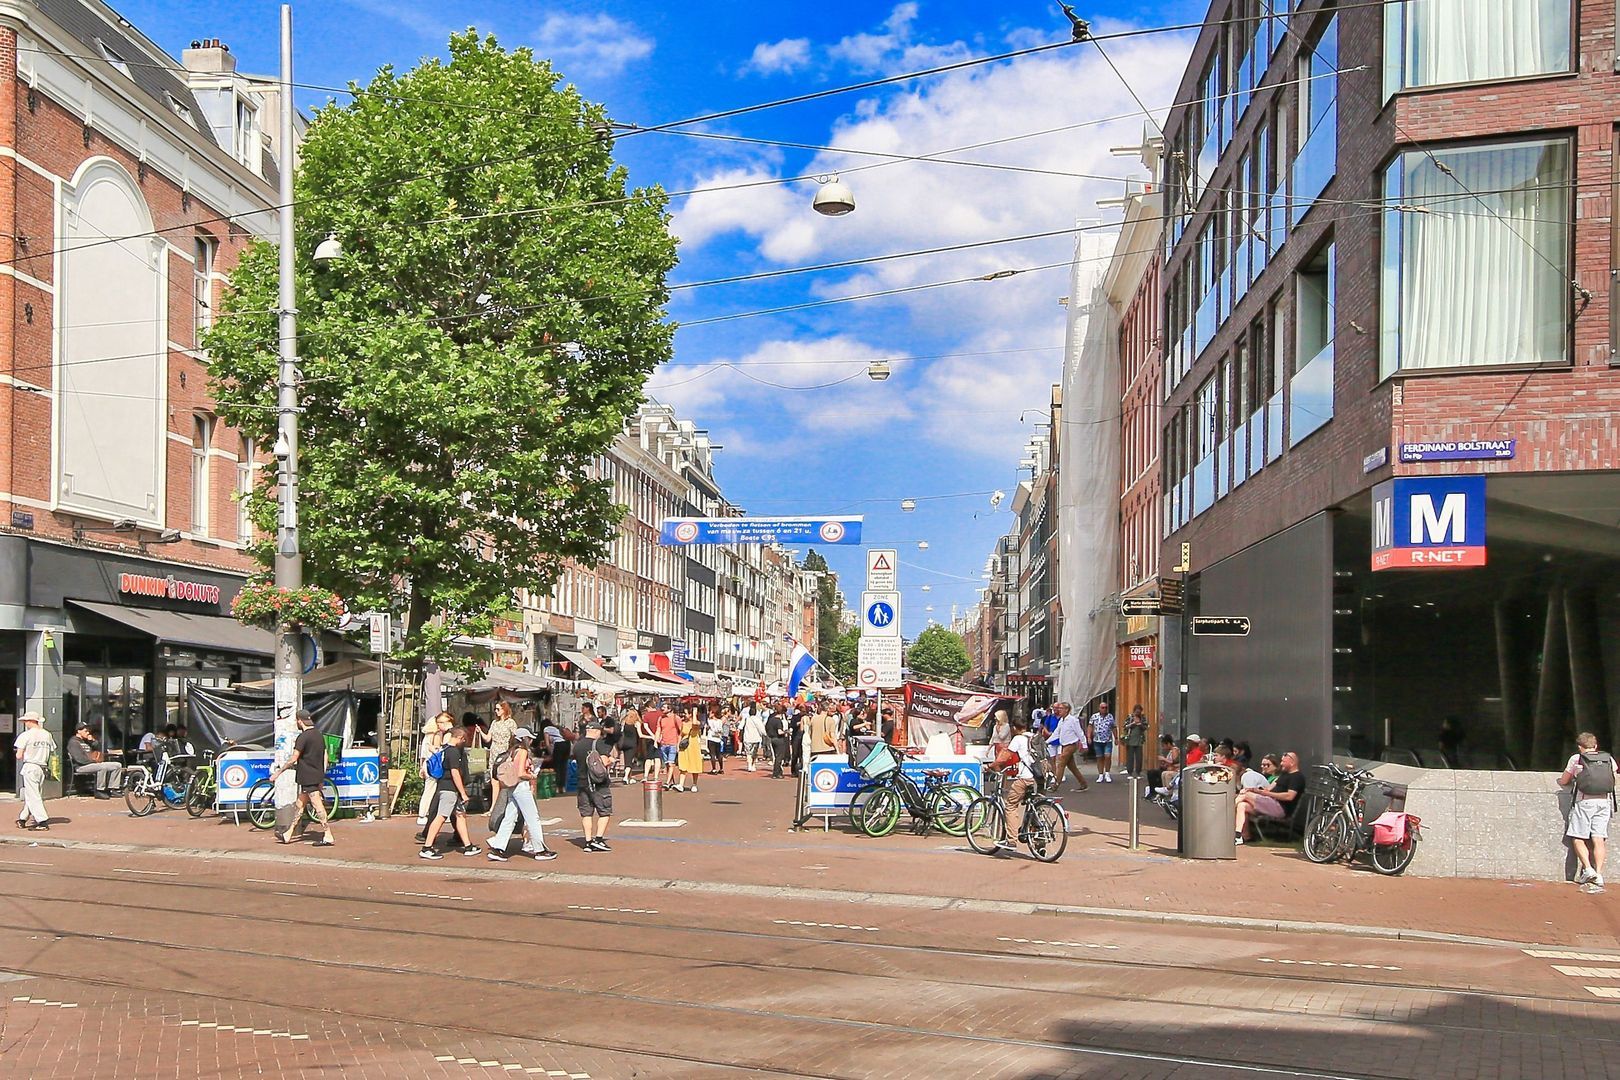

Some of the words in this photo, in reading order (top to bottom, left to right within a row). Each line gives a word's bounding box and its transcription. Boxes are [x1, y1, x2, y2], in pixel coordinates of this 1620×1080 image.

[1403, 443, 1456, 453] FERDINAND
[1458, 441, 1511, 451] BOLSTRAAT
[1410, 493, 1466, 544] M
[121, 572, 168, 597] DUNKIN'
[177, 581, 220, 604] DONUTS
[1130, 647, 1151, 655] COFFEE
[911, 703, 950, 717] Nieuwe
